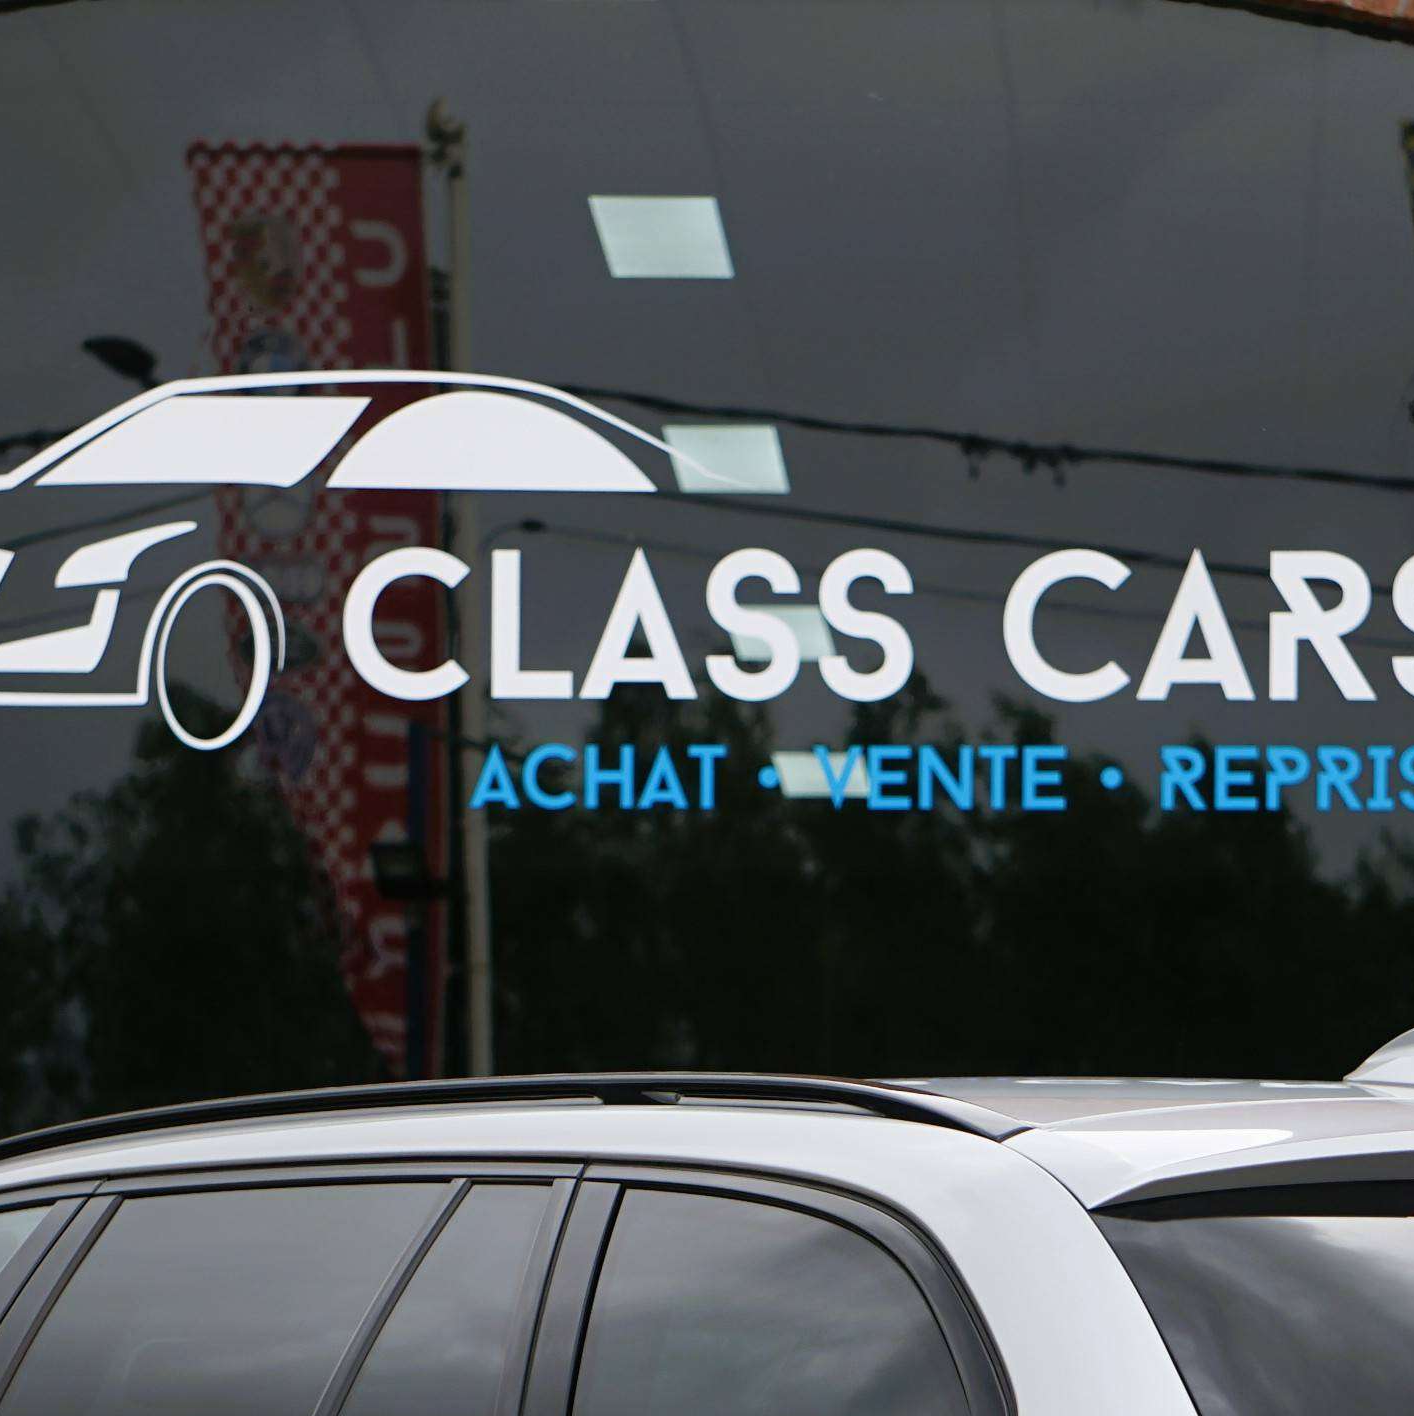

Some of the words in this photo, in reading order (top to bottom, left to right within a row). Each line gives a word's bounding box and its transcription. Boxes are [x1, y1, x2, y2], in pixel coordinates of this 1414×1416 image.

[343, 547, 913, 702] CLASS
[469, 743, 729, 811] ACHAT
[813, 743, 1069, 812] VENTE
